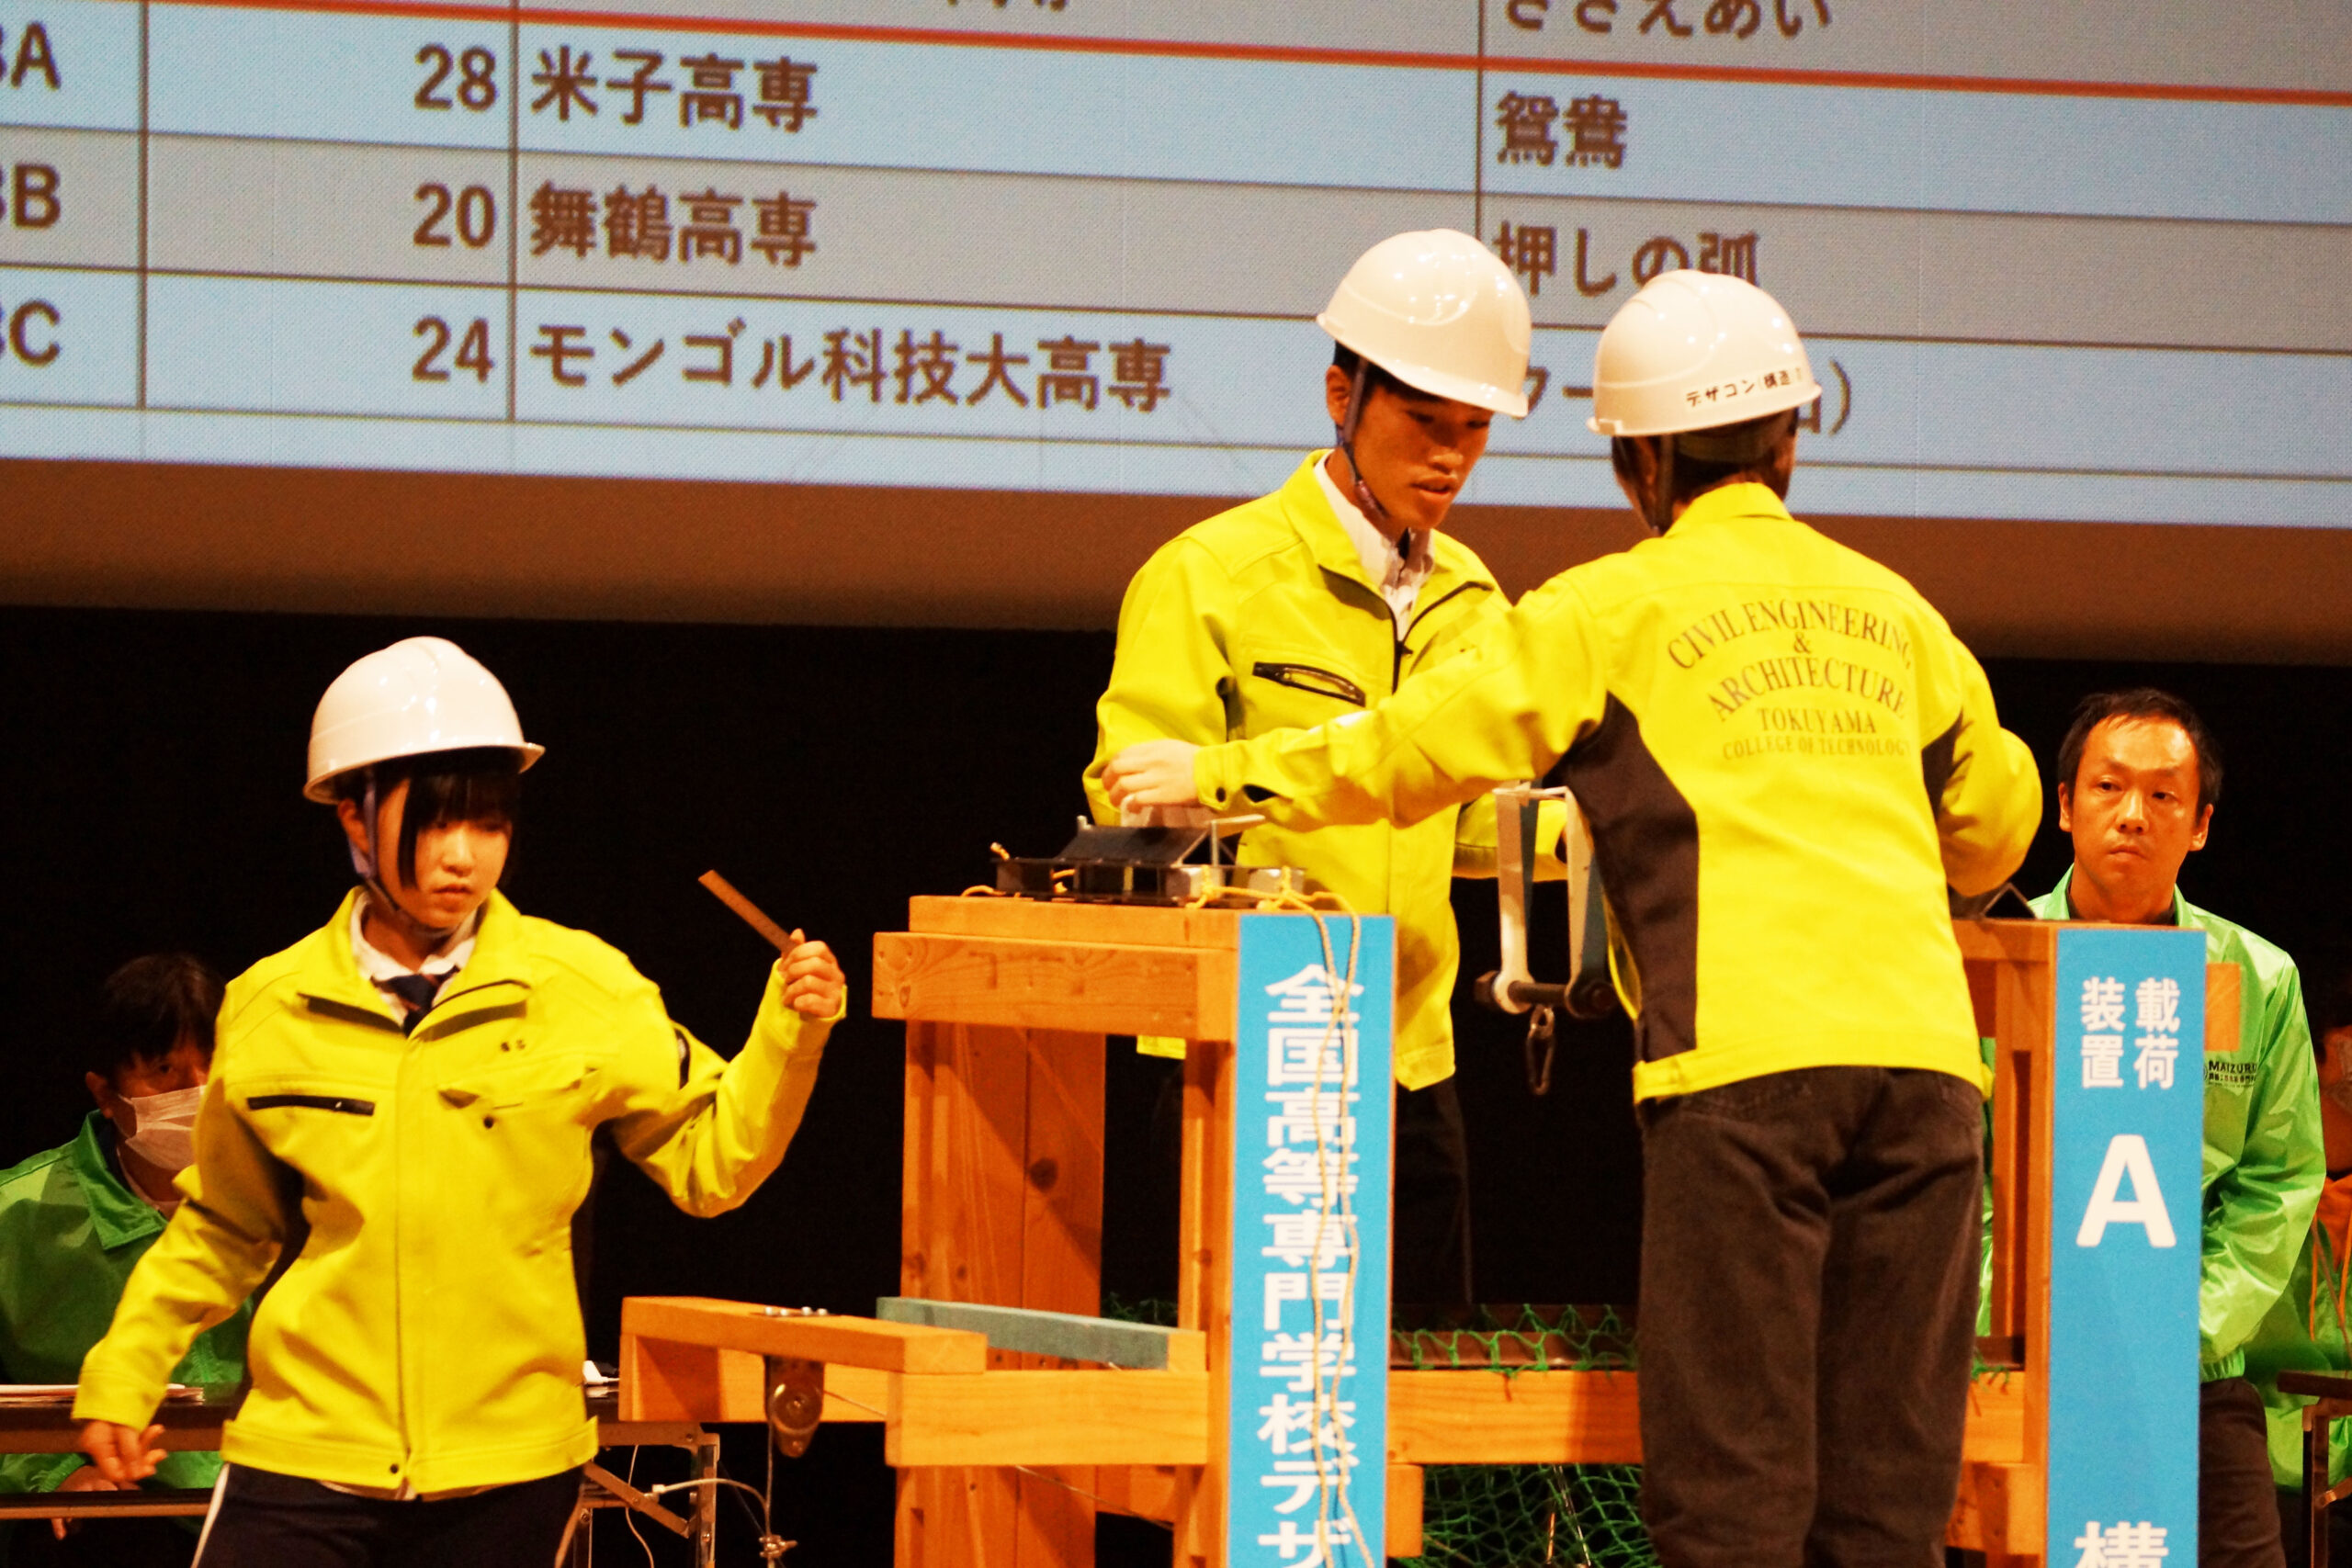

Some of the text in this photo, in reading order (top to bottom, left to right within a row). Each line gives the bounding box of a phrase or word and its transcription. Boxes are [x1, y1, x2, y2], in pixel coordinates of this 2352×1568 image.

[0, 20, 62, 90] A
[413, 44, 500, 111] 28
[530, 44, 818, 133] 米子高専
[1495, 91, 1628, 170] 鴛鴦
[0, 163, 62, 230] B
[413, 183, 497, 249] 20
[529, 180, 818, 268] 舞鶴高専
[0, 298, 62, 367] C
[412, 316, 496, 383] 24
[529, 316, 1171, 412] モンゴル科技大高専
[1667, 608, 1744, 670] CIVIL
[1792, 630, 1813, 656] &
[1706, 656, 1907, 722] ARCHITECTURE
[1757, 706, 1877, 735] TOKUYAMA
[1722, 735, 1793, 761] COLLEGE
[1798, 737, 1816, 756] OF
[2075, 1134, 2177, 1248] A
